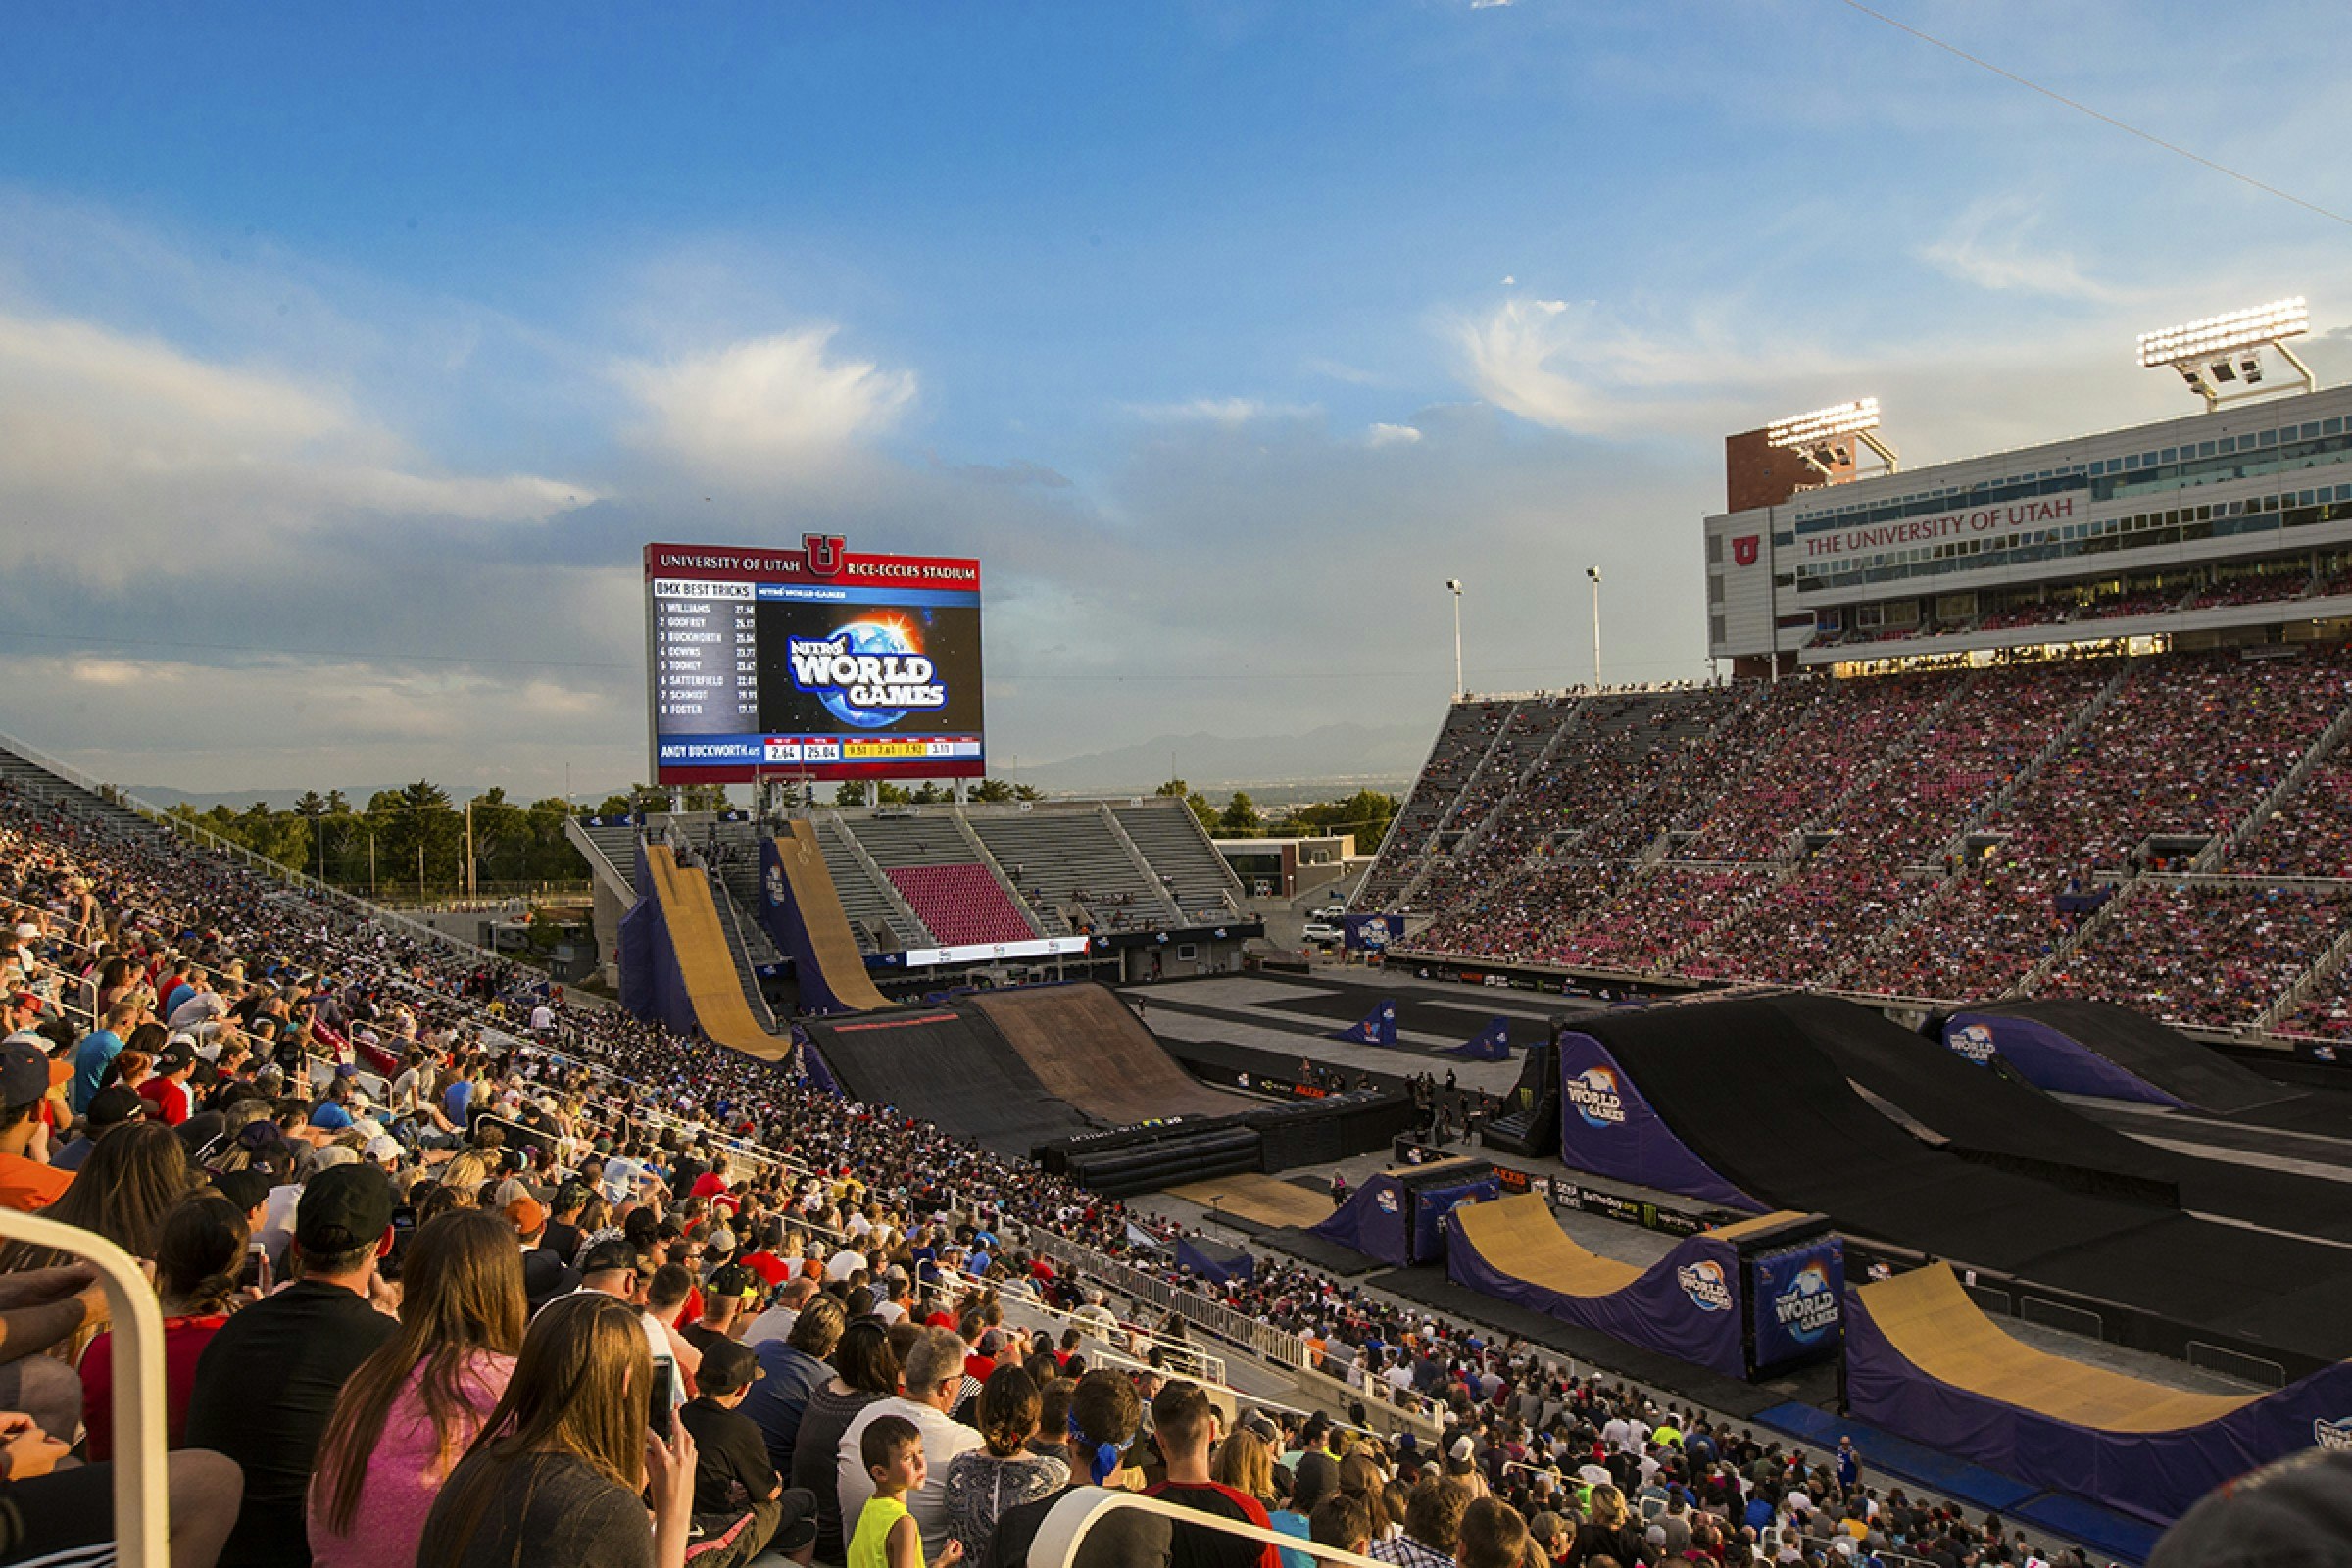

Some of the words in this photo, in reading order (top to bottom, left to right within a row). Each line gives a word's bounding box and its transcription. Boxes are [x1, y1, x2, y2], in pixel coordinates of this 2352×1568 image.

[1806, 534, 1841, 557] THE
[1847, 515, 1965, 551] UNIVERSITY
[1970, 509, 2001, 532] OF
[2007, 497, 2074, 526] UTAH
[1731, 534, 1760, 566] U
[660, 554, 740, 570] UNIVERSITY
[742, 558, 762, 571] OF
[764, 559, 801, 572] UTAH
[847, 562, 920, 578] RICE-ECCLES
[922, 565, 976, 580] STADIUM
[683, 583, 709, 596] BEST
[791, 656, 933, 684] WORLD
[850, 685, 944, 707] GAMES
[1568, 1086, 1622, 1109] WORLD
[1775, 1291, 1834, 1324] WORLD
[1800, 1306, 1839, 1332] GAMES
